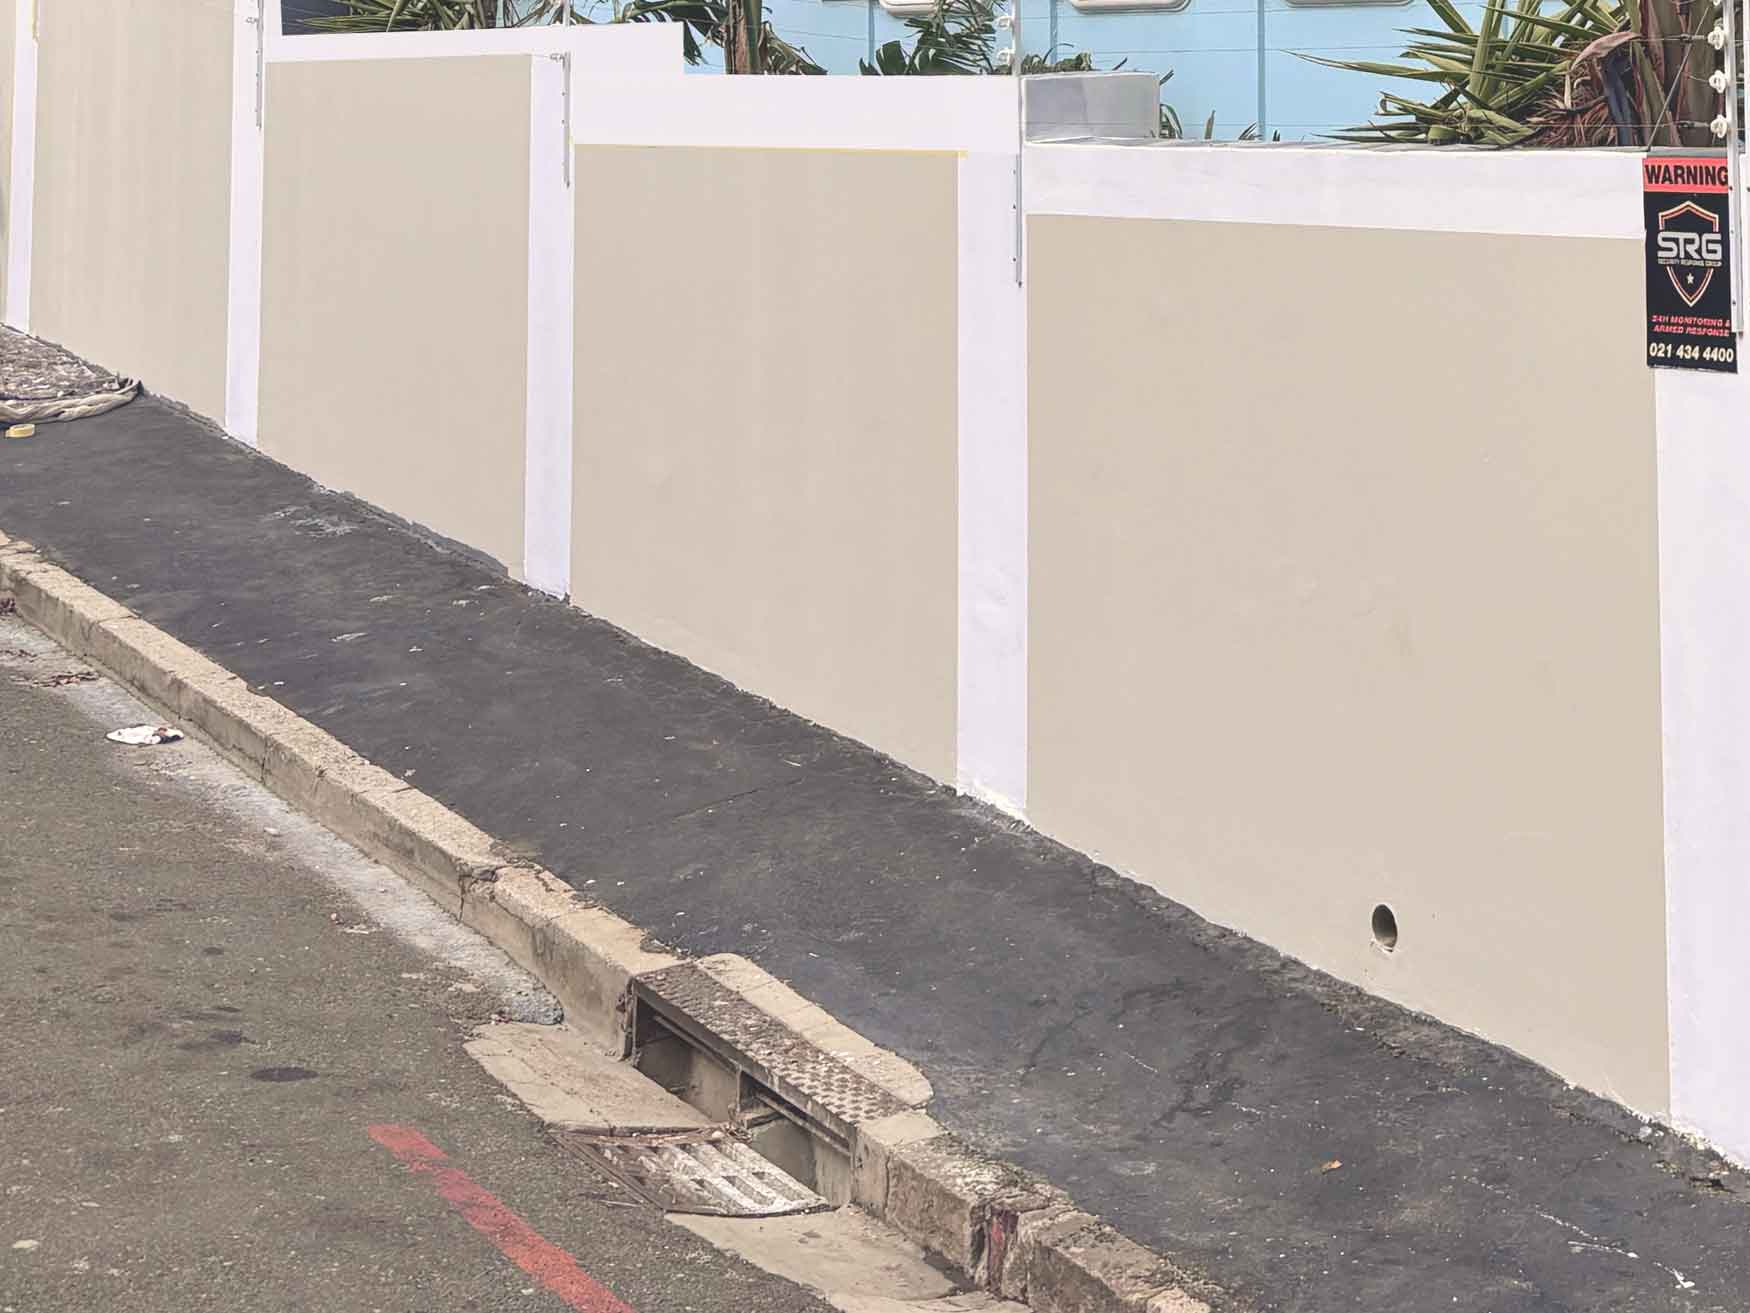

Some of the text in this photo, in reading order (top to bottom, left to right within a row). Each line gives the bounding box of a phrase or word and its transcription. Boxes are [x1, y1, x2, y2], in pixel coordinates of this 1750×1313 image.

[1645, 164, 1728, 187] WARNING
[1657, 232, 1722, 260] SRG
[1649, 342, 1734, 363] 021 434 4400
